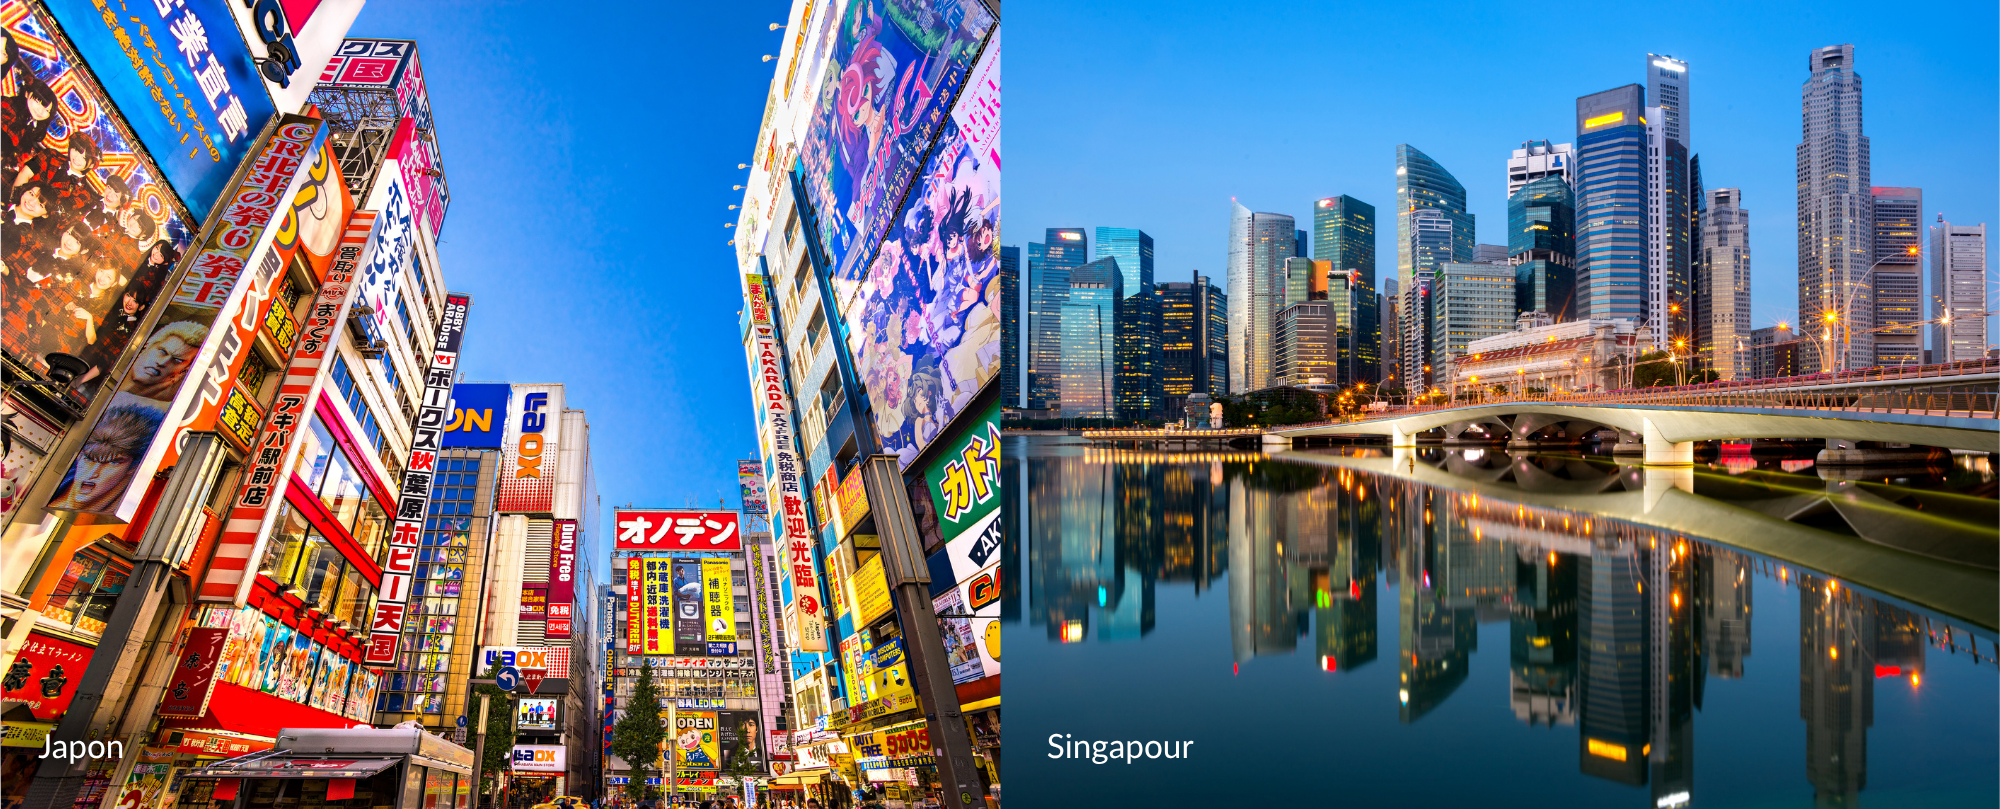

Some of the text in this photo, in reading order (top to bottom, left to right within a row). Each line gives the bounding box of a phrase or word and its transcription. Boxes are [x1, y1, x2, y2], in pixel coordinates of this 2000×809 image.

[246, 0, 302, 89] CE
[333, 246, 361, 283] 買取り
[304, 303, 337, 354] まっくす
[437, 296, 457, 350] PARADISE
[453, 297, 468, 332] HOBBY
[760, 342, 784, 410] TAKARADA
[219, 404, 255, 446] 査定
[226, 386, 264, 430] 高額
[242, 395, 302, 506] アキバ駅前店
[777, 452, 798, 493] 免税商店
[845, 464, 863, 497] FREE
[552, 523, 562, 568] Flagship Store
[618, 513, 736, 546] オノデン
[784, 495, 815, 588] 歓迎光臨
[559, 523, 576, 582] Duty Free
[629, 559, 640, 581] 免税
[550, 605, 570, 616] 免税
[708, 577, 722, 617] 補聴器
[548, 622, 569, 632] 면세점
[606, 596, 616, 644] Panasonic
[193, 632, 223, 687] ラーメン
[877, 640, 897, 656] DISCOUNT
[877, 647, 902, 664] COMPUTERS
[606, 649, 614, 690] ONODEN
[660, 718, 714, 730] OODEN
[854, 733, 874, 746] DUTY
[861, 744, 883, 758] FREE
